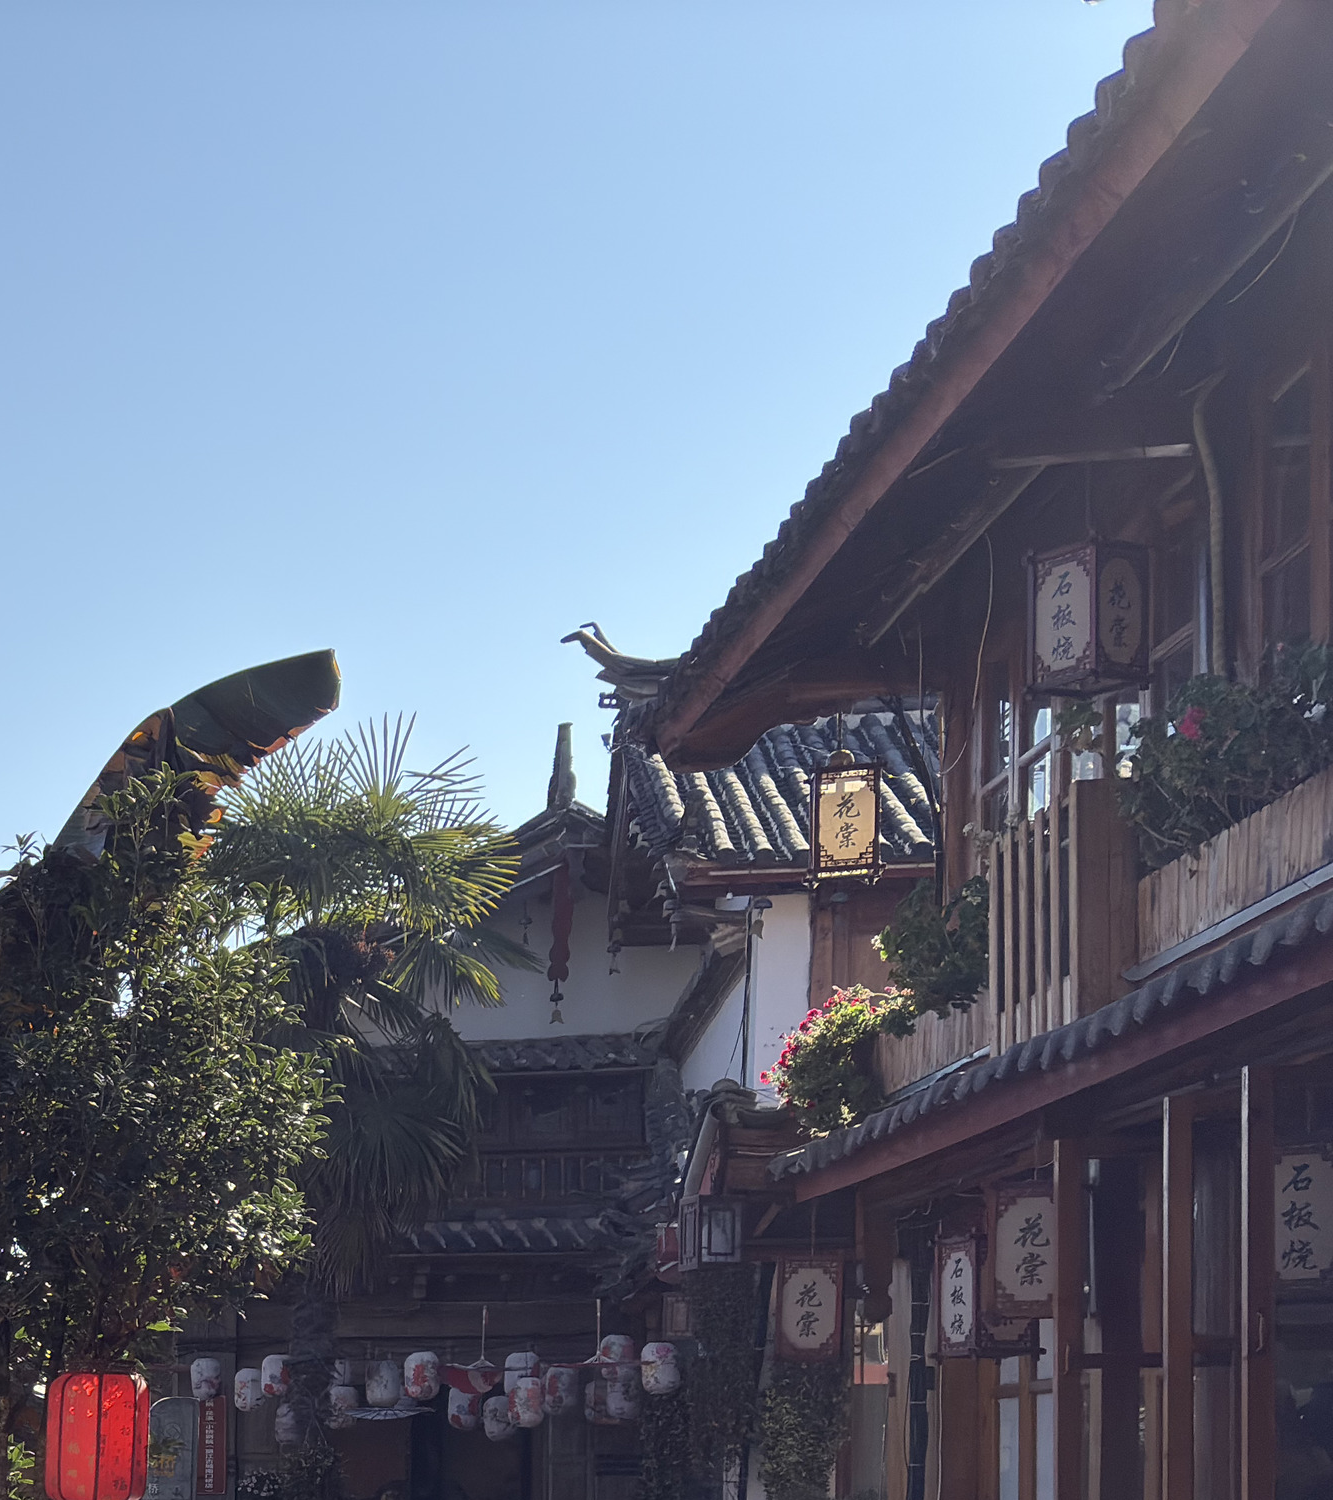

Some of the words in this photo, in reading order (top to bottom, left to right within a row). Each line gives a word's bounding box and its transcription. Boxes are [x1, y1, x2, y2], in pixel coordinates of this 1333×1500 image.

[1051, 570, 1077, 662] 石板烧
[1281, 1163, 1320, 1270] 石板烧
[949, 1257, 967, 1336] 石板烧
